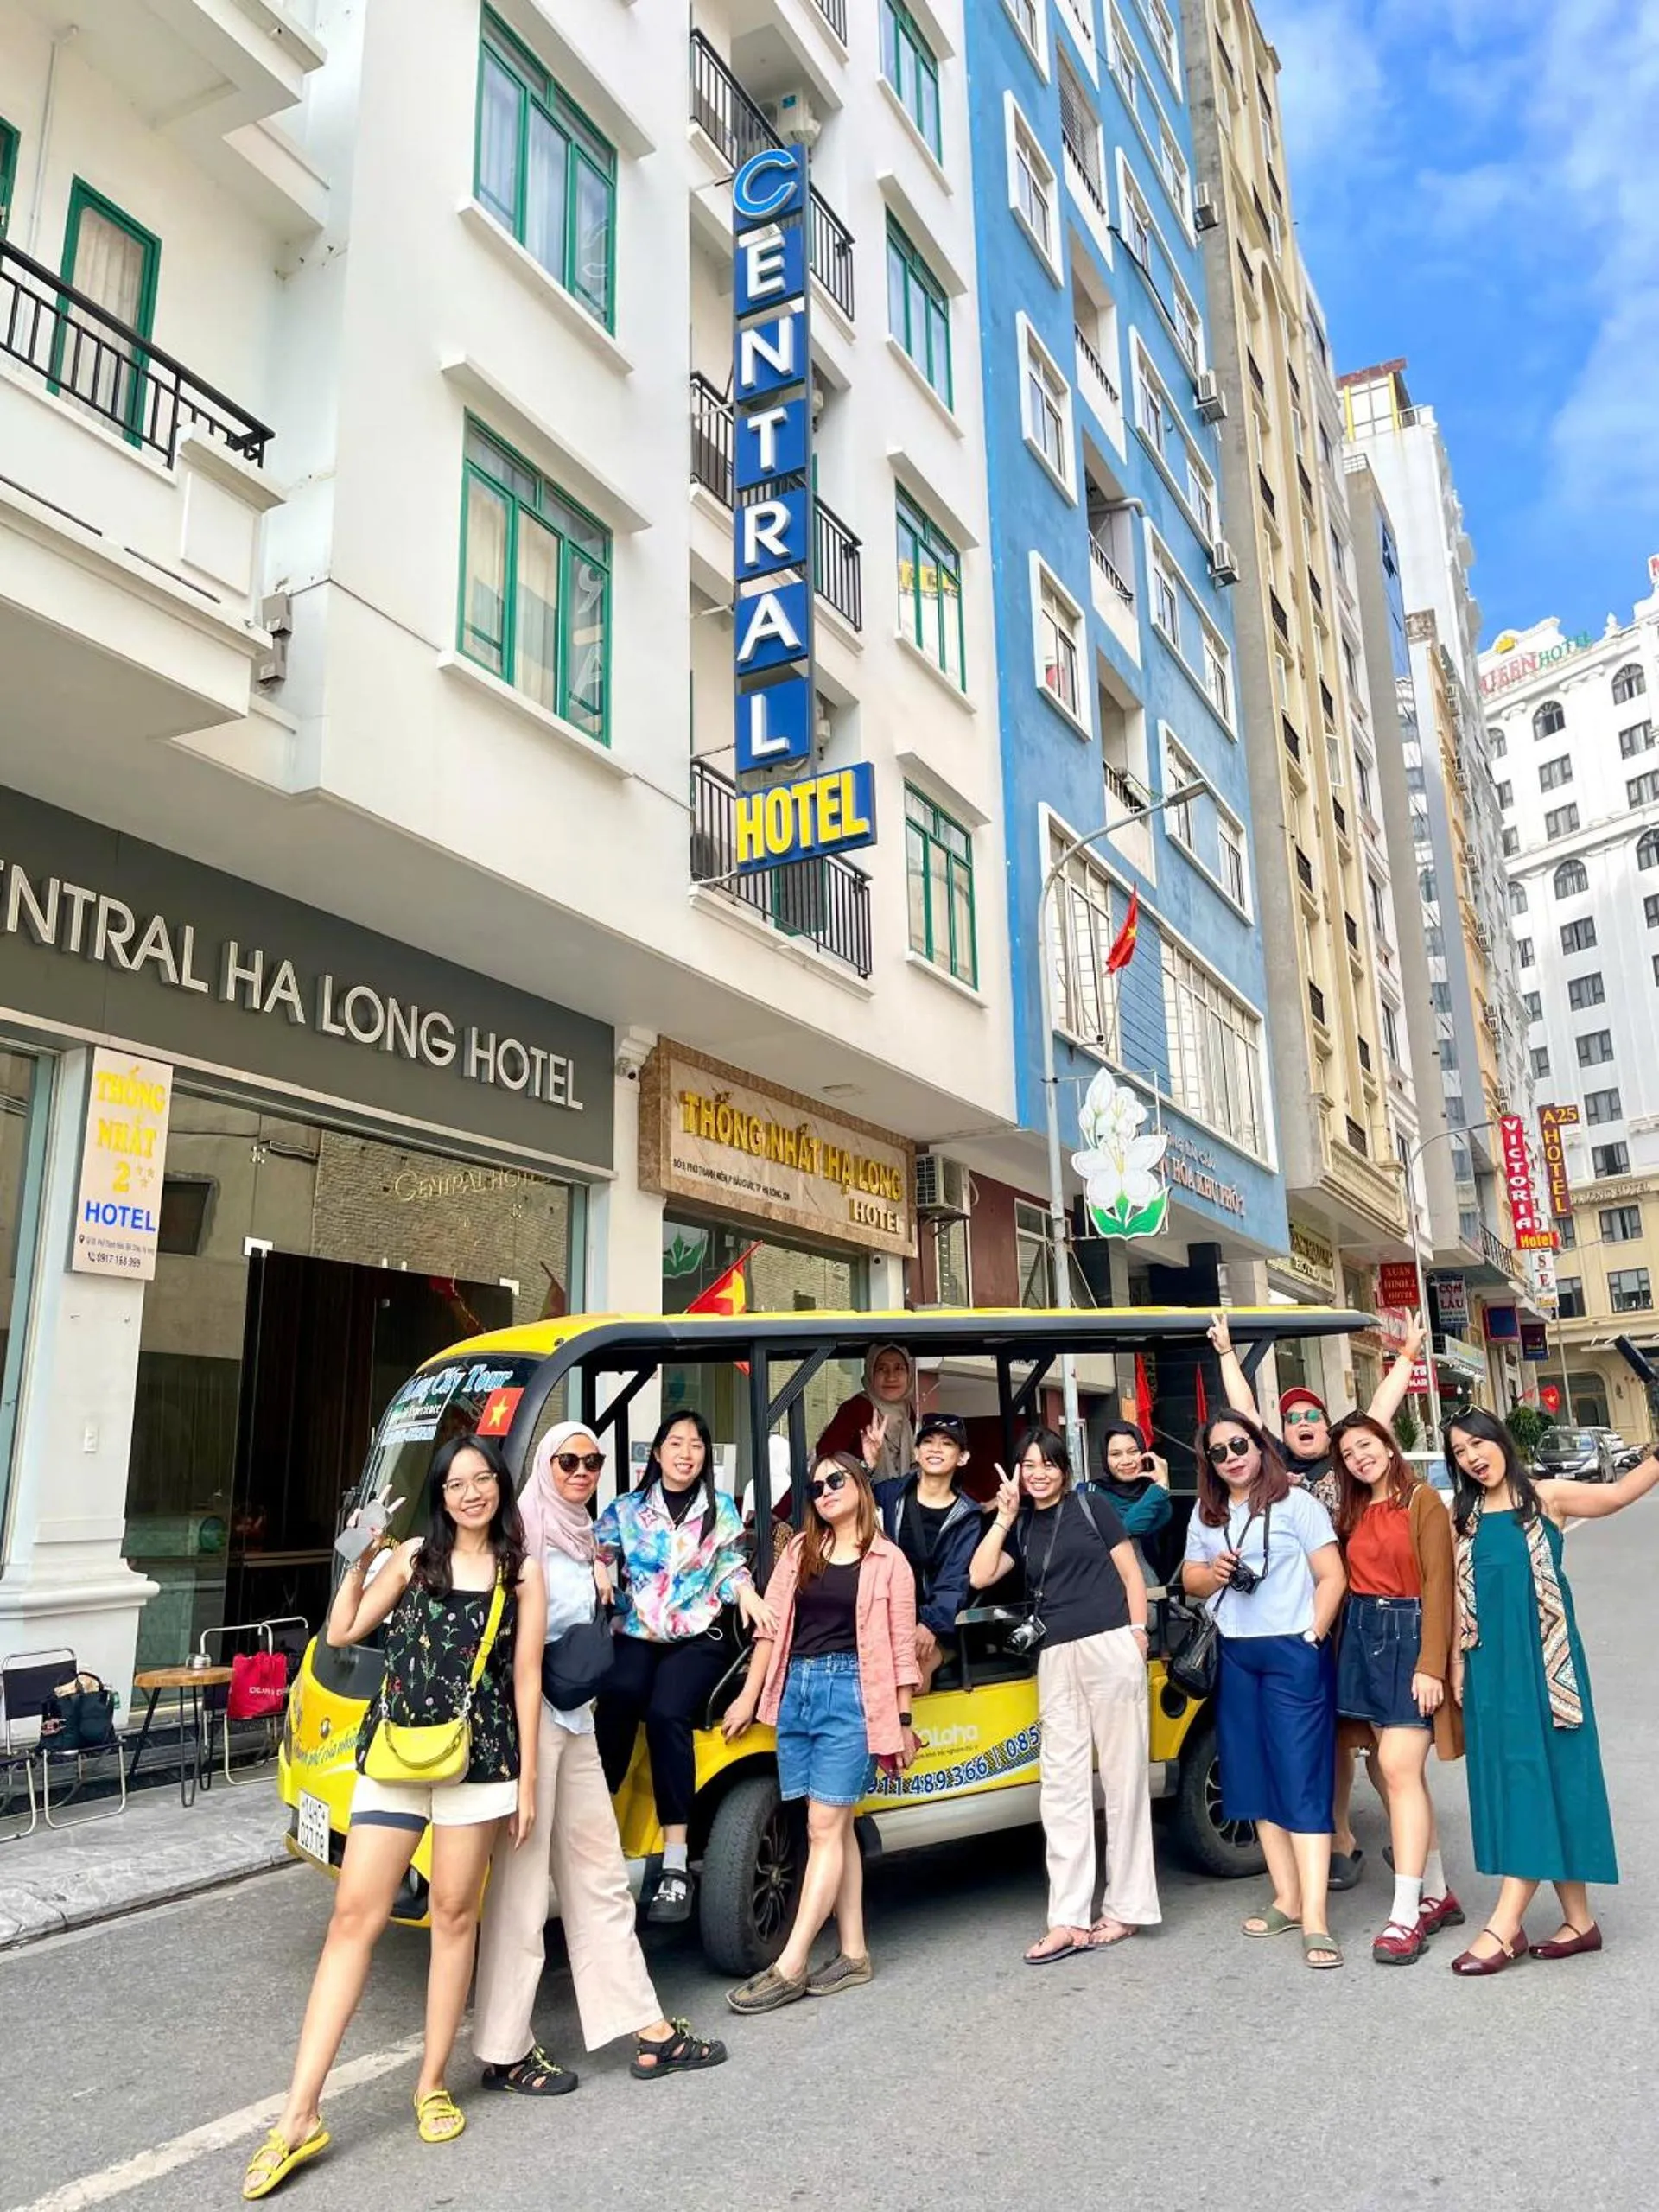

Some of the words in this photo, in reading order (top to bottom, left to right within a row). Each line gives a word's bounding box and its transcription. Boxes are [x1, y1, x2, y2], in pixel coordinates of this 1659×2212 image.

[732, 149, 805, 759] CENTRAL
[1480, 652, 1538, 695] UEEN
[737, 766, 870, 865] HOTEL
[0, 859, 210, 994] NTRAL
[219, 939, 306, 1025] HA
[316, 974, 456, 1067] LONG
[463, 1026, 583, 1111] HOTEL
[1542, 1107, 1578, 1124] A25
[112, 1161, 130, 1192] 2
[853, 1154, 905, 1203] LONG
[1503, 1120, 1533, 1230] VICTORIA
[1543, 1128, 1567, 1213] HOTEL
[85, 1199, 156, 1232] HOTEL
[849, 1198, 903, 1236] HOTEL
[1520, 1232, 1553, 1248] Hotel
[462, 1363, 514, 1393] Tour
[1006, 1726, 1041, 1758] 085
